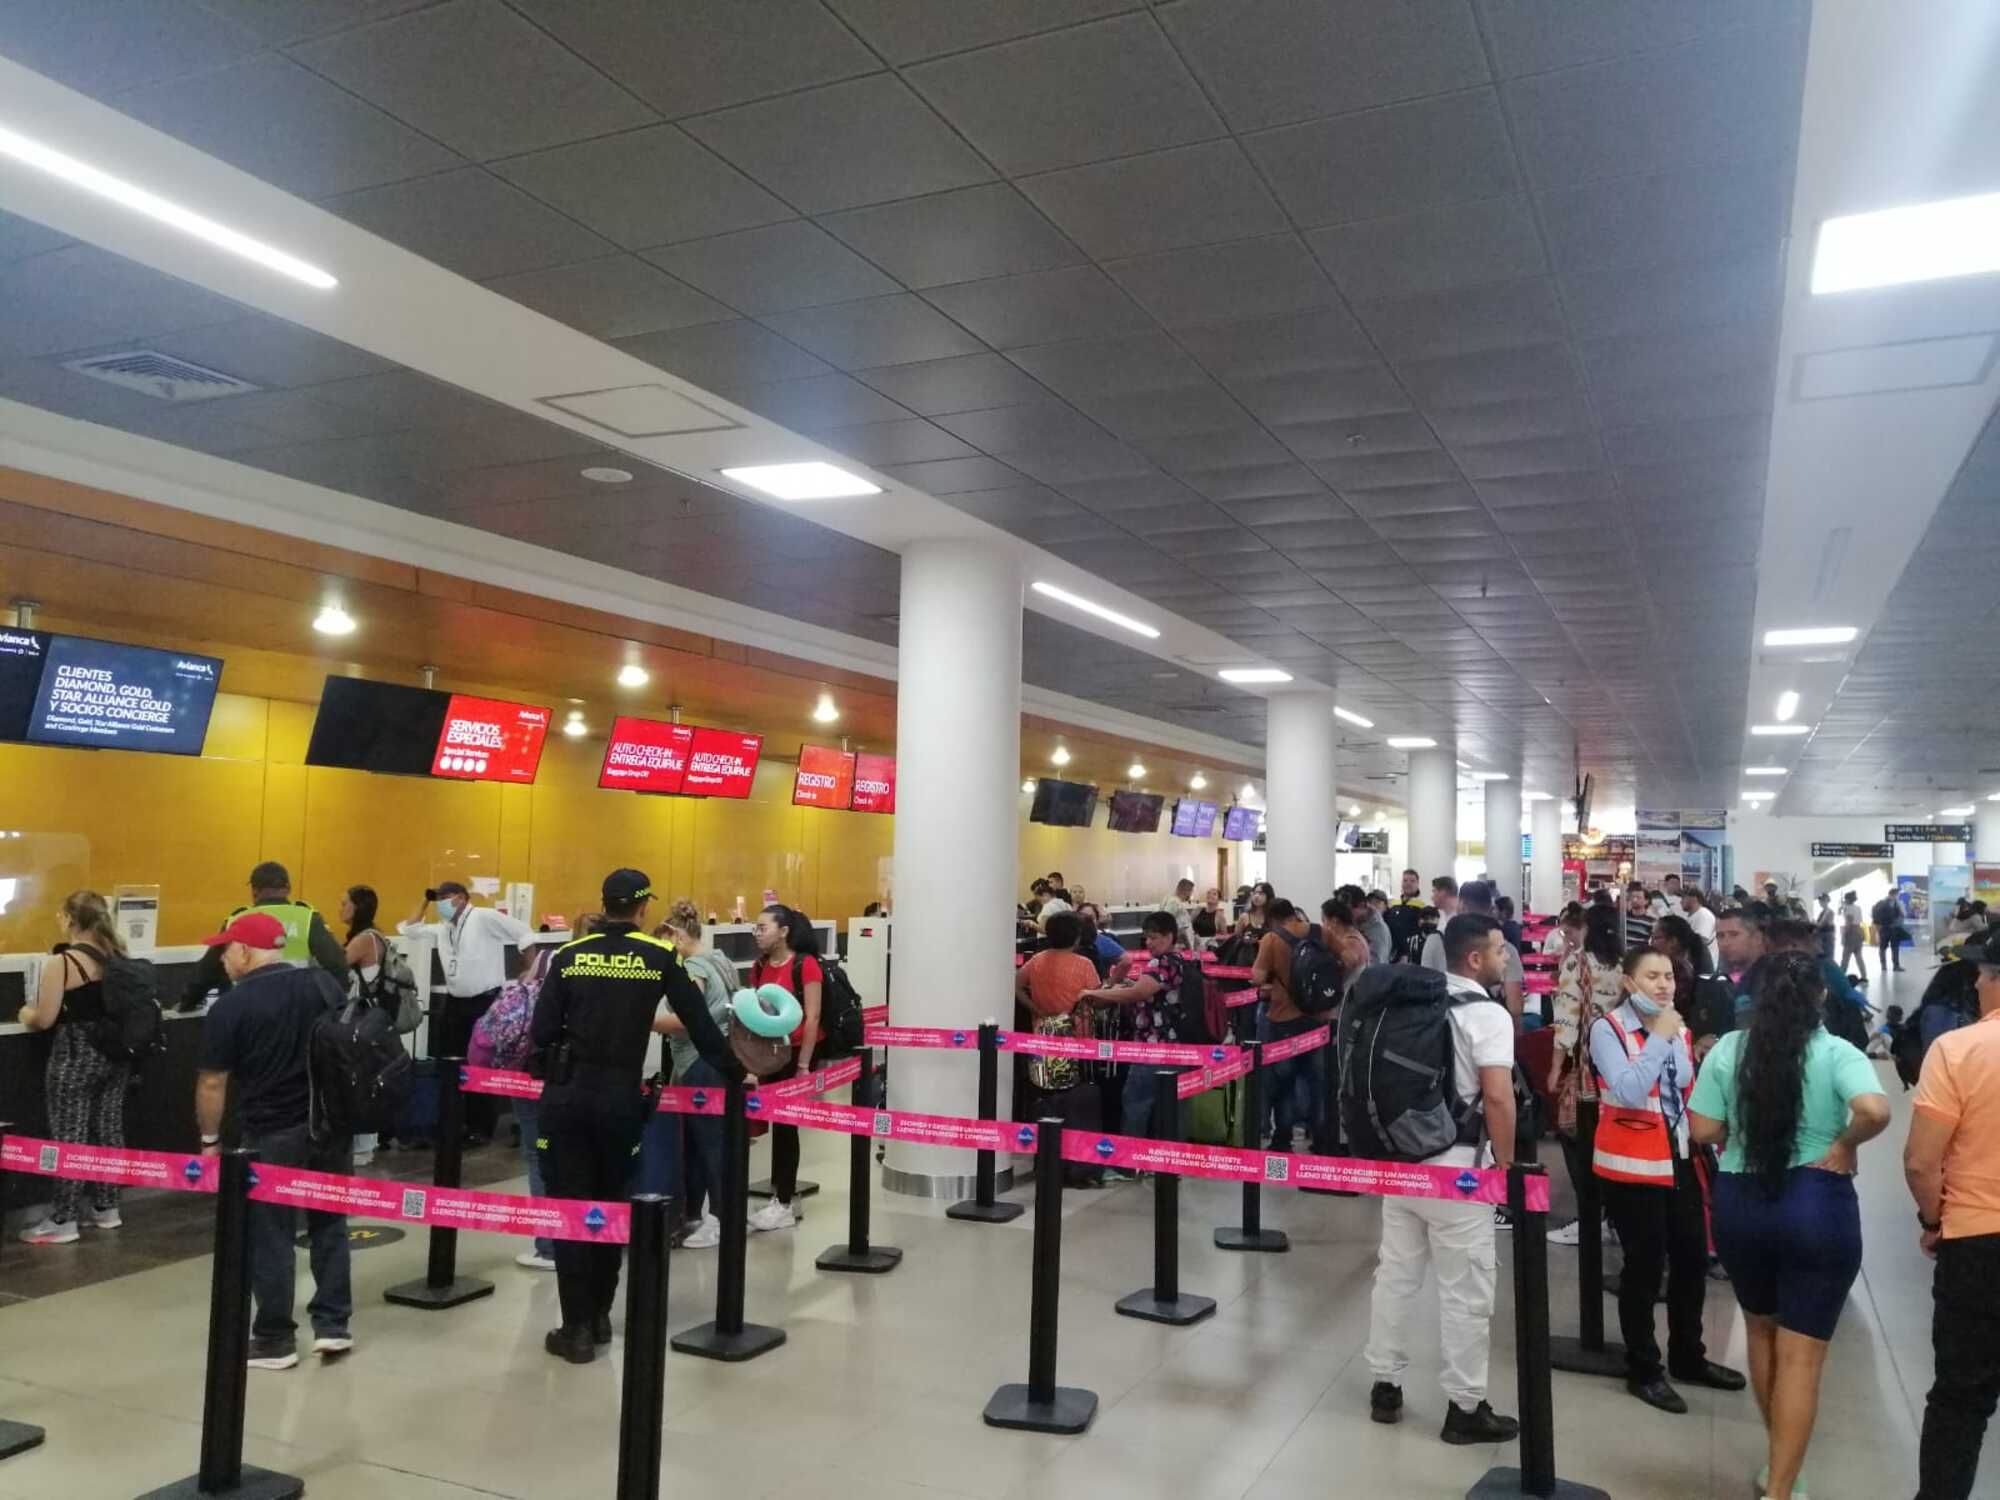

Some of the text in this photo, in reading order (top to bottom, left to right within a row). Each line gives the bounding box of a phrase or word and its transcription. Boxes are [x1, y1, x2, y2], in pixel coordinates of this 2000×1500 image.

[0, 633, 30, 646] vianca
[57, 664, 112, 682] CLIENTES
[54, 676, 152, 699] DIAMOND, GOLD,
[51, 688, 171, 712] STAR ALLIANCE GOLD
[49, 700, 169, 723] Y SOCIOS CONCIERGE
[450, 719, 501, 736] SERVICIOS
[447, 732, 503, 748] ESPECIALES
[612, 742, 636, 756] AUTO
[610, 753, 685, 771] ENTREGA EQUIPAJE
[692, 752, 712, 764] AUTO
[690, 761, 752, 777] ENTREGA EQUIPAJE
[799, 772, 836, 789] REGISTRO
[856, 780, 890, 794] REGISTRO
[575, 952, 645, 969] POLICÍA
